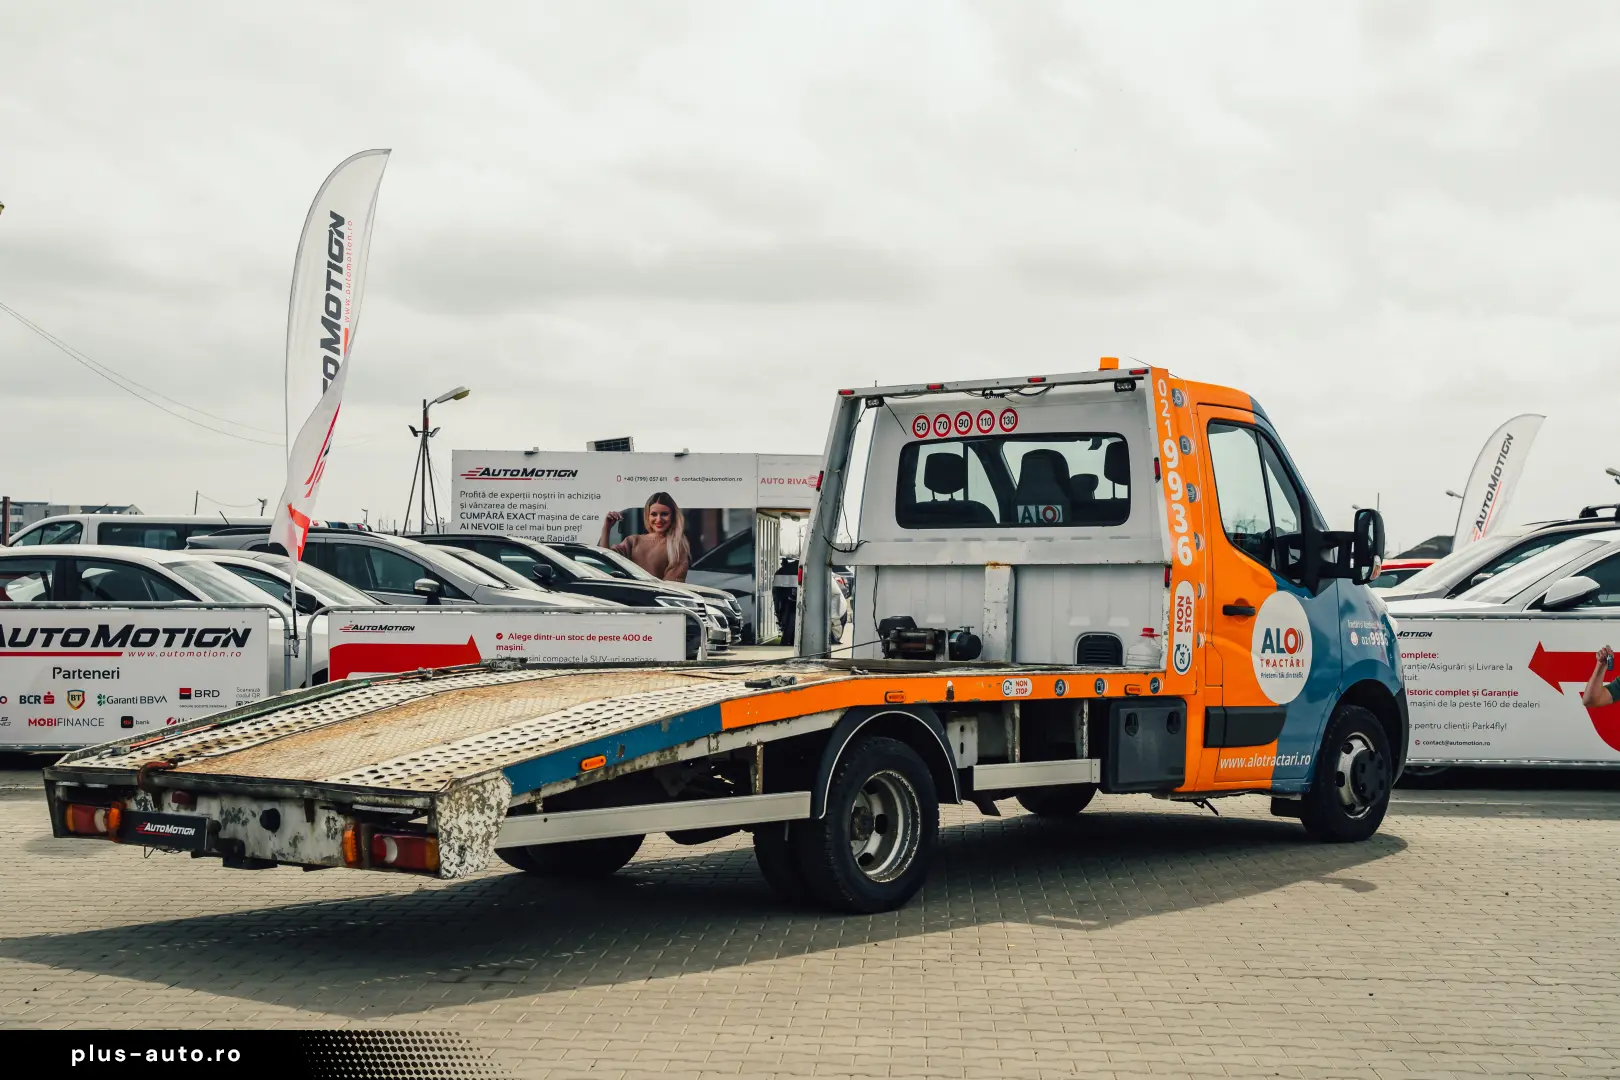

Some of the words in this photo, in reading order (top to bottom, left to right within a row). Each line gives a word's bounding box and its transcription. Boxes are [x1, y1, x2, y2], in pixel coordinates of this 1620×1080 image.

[345, 220, 353, 323] www.automotion.ro
[937, 421, 948, 430] 70
[958, 419, 969, 428] 90
[980, 417, 992, 427] 110
[1002, 416, 1015, 425] 130
[916, 422, 927, 431] 50
[460, 490, 486, 499] Profită
[489, 491, 498, 499] de
[500, 491, 530, 503] experții
[532, 492, 556, 502] noștri
[567, 492, 601, 500] achiziția
[460, 502, 467, 510] și
[460, 511, 505, 520] CUMPĂRĂ
[538, 513, 568, 521] mașina
[1020, 505, 1057, 523] ALO
[1176, 596, 1184, 633] NON
[1184, 596, 1192, 633] STOP
[508, 633, 532, 642] Alege
[534, 633, 566, 641] dintr-un
[586, 633, 596, 641] de
[599, 635, 620, 643] peste
[622, 634, 640, 642] 400
[642, 634, 652, 642] de
[1261, 627, 1299, 654] ALO
[128, 649, 242, 657] www.automotion.ro
[496, 644, 525, 652] mașini.
[543, 655, 580, 663] compacte
[582, 655, 588, 663] la
[1180, 651, 1186, 664] 24
[1401, 652, 1439, 660] omplete:
[1260, 656, 1304, 667] TRACTĂRI
[1468, 663, 1475, 672] și
[1476, 663, 1504, 671] Livrare
[1506, 663, 1513, 671] la
[52, 667, 120, 680] Parteneri
[194, 689, 220, 698] BRD
[1407, 688, 1433, 696] Istoric
[1435, 689, 1470, 697] complet
[1472, 689, 1479, 698] și
[1481, 689, 1519, 698] Garanție
[19, 695, 42, 704] BCR
[106, 695, 138, 705] Garanti
[140, 695, 168, 704] BBVA
[1410, 701, 1436, 709] mașini
[28, 717, 105, 727] MOBIFINANCE
[1415, 723, 1442, 731] pentru
[1444, 722, 1470, 732] clienții
[1472, 722, 1507, 732] Park4fly!
[1220, 752, 1311, 769] www.alotractari.ro
